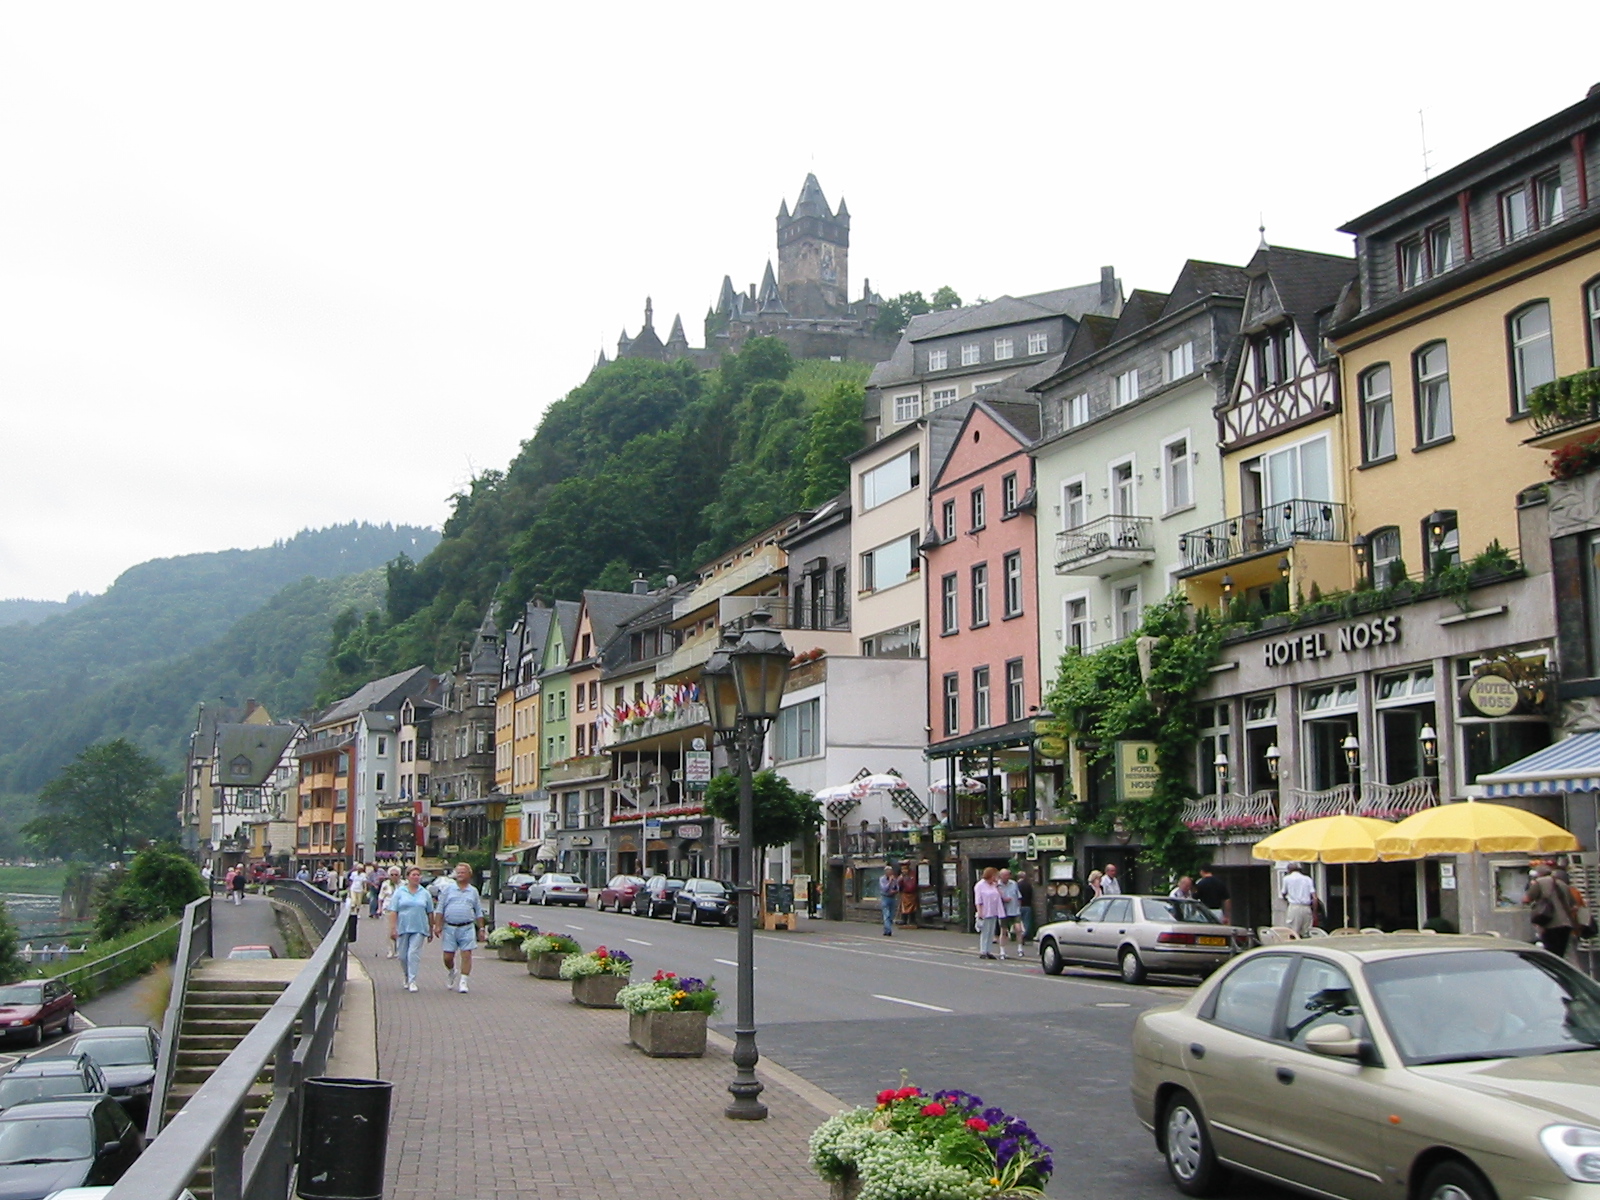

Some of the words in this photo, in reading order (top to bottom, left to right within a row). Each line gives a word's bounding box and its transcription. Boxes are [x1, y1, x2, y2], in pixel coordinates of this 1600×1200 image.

[1262, 633, 1327, 666] HOTEL
[1337, 616, 1398, 652] NOSS
[1476, 682, 1514, 694] HOTEL
[1478, 696, 1511, 708] NOSS
